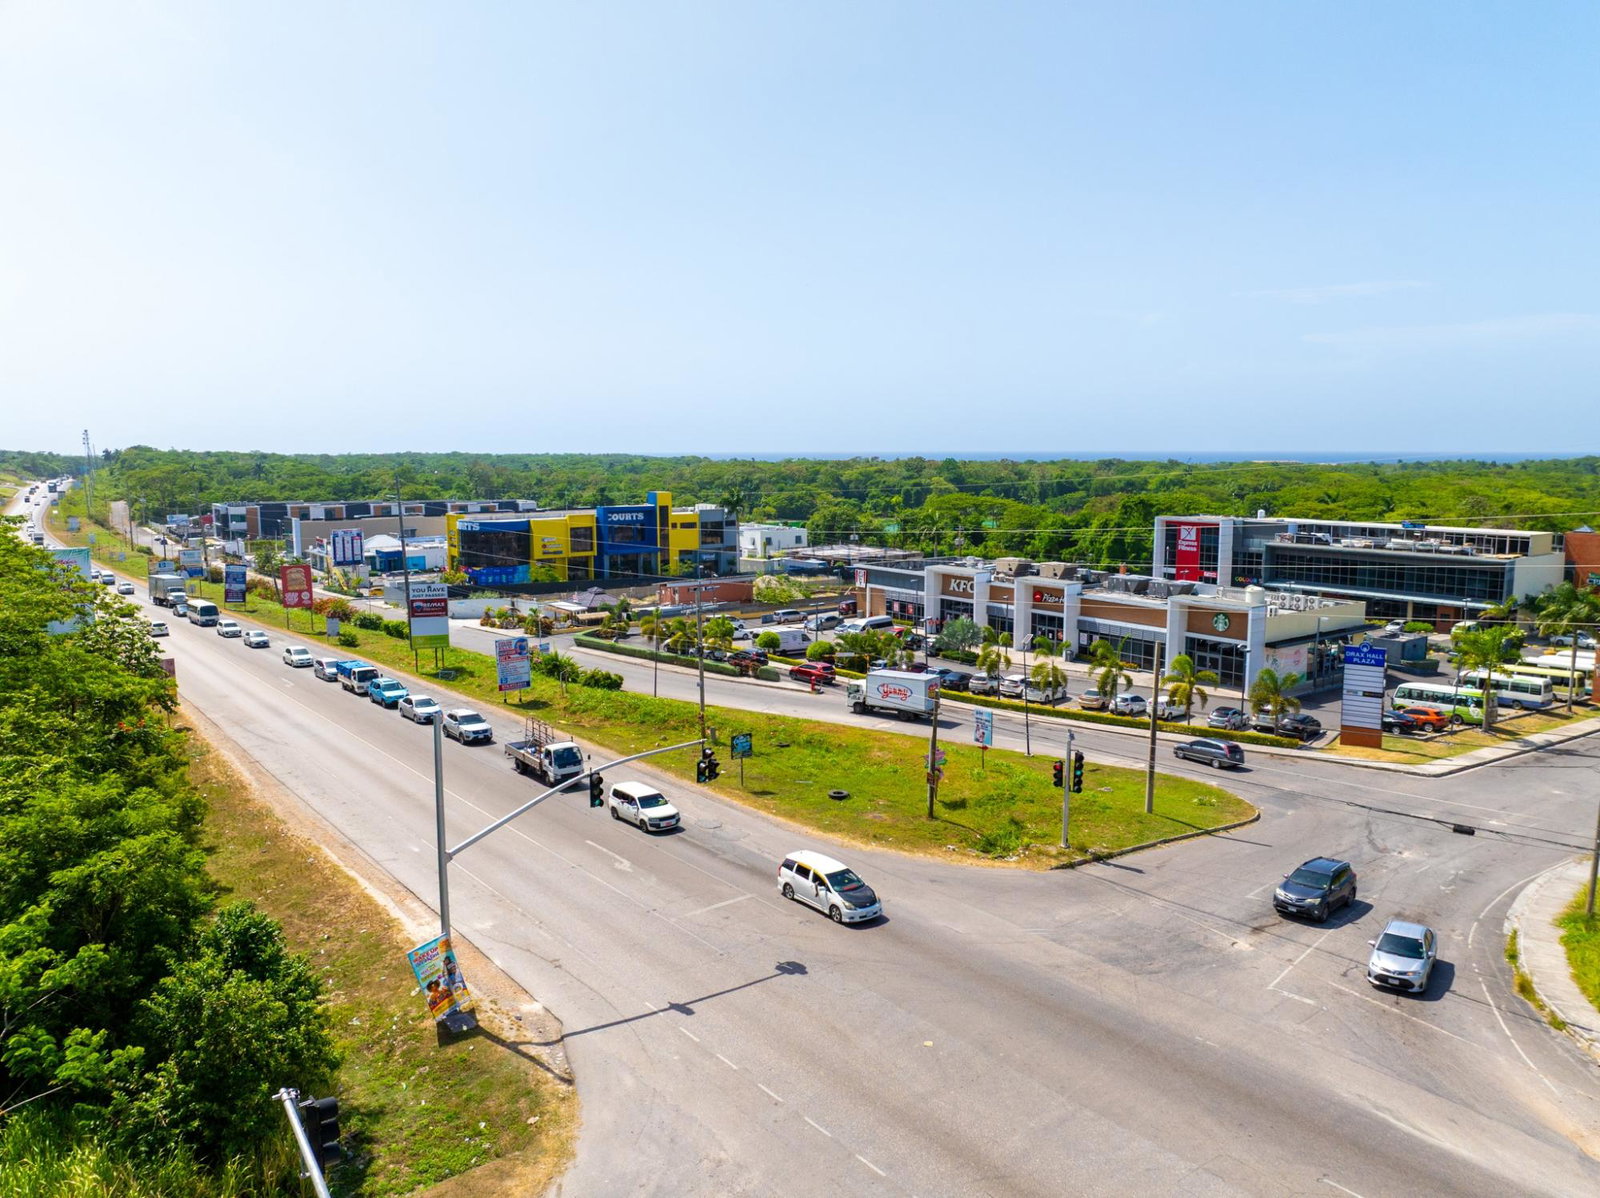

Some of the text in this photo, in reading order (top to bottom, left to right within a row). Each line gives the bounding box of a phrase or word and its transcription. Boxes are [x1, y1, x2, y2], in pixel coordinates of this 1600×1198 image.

[427, 585, 446, 593] HAVE
[949, 578, 975, 594] KFC
[1352, 657, 1376, 665] PLAZA
